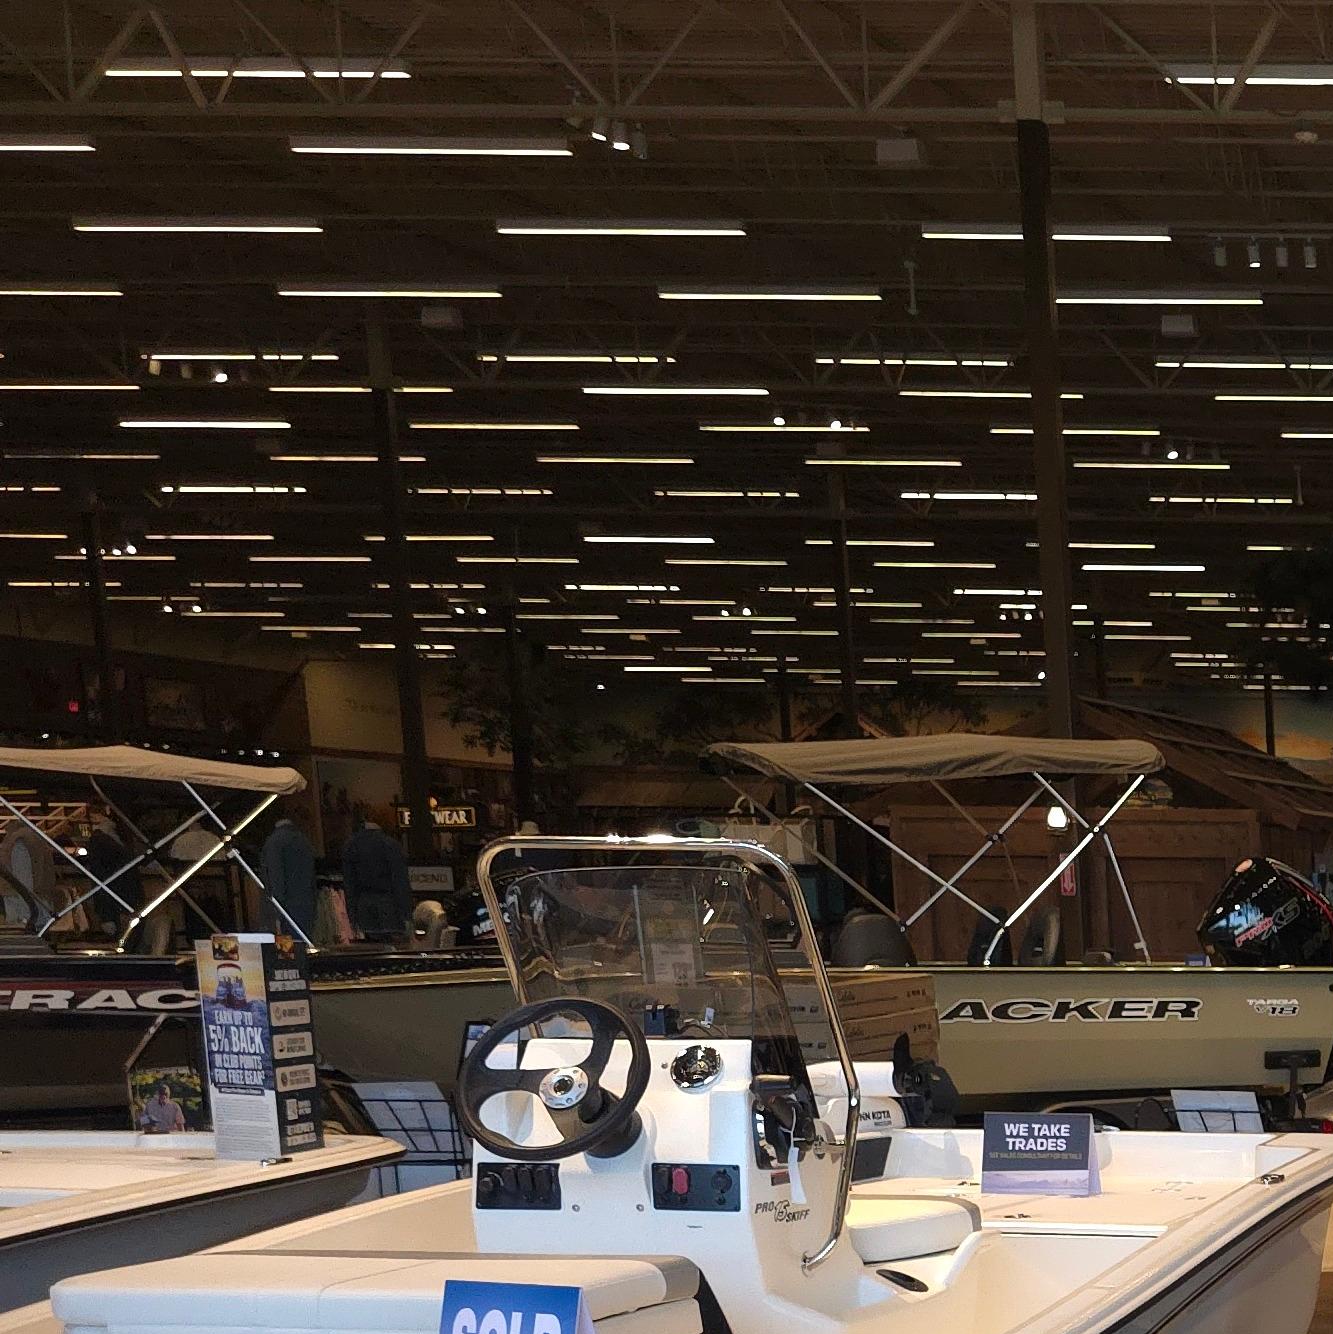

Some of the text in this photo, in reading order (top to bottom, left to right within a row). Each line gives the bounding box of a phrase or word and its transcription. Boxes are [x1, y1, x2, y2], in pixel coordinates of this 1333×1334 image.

[939, 998, 1204, 1023] ACKER
[208, 1024, 229, 1052] 5%
[230, 1027, 265, 1055] BACK
[1003, 1123, 1071, 1137] WE TAKE
[1005, 1138, 1068, 1152] TRADES
[754, 1200, 776, 1214] PRO
